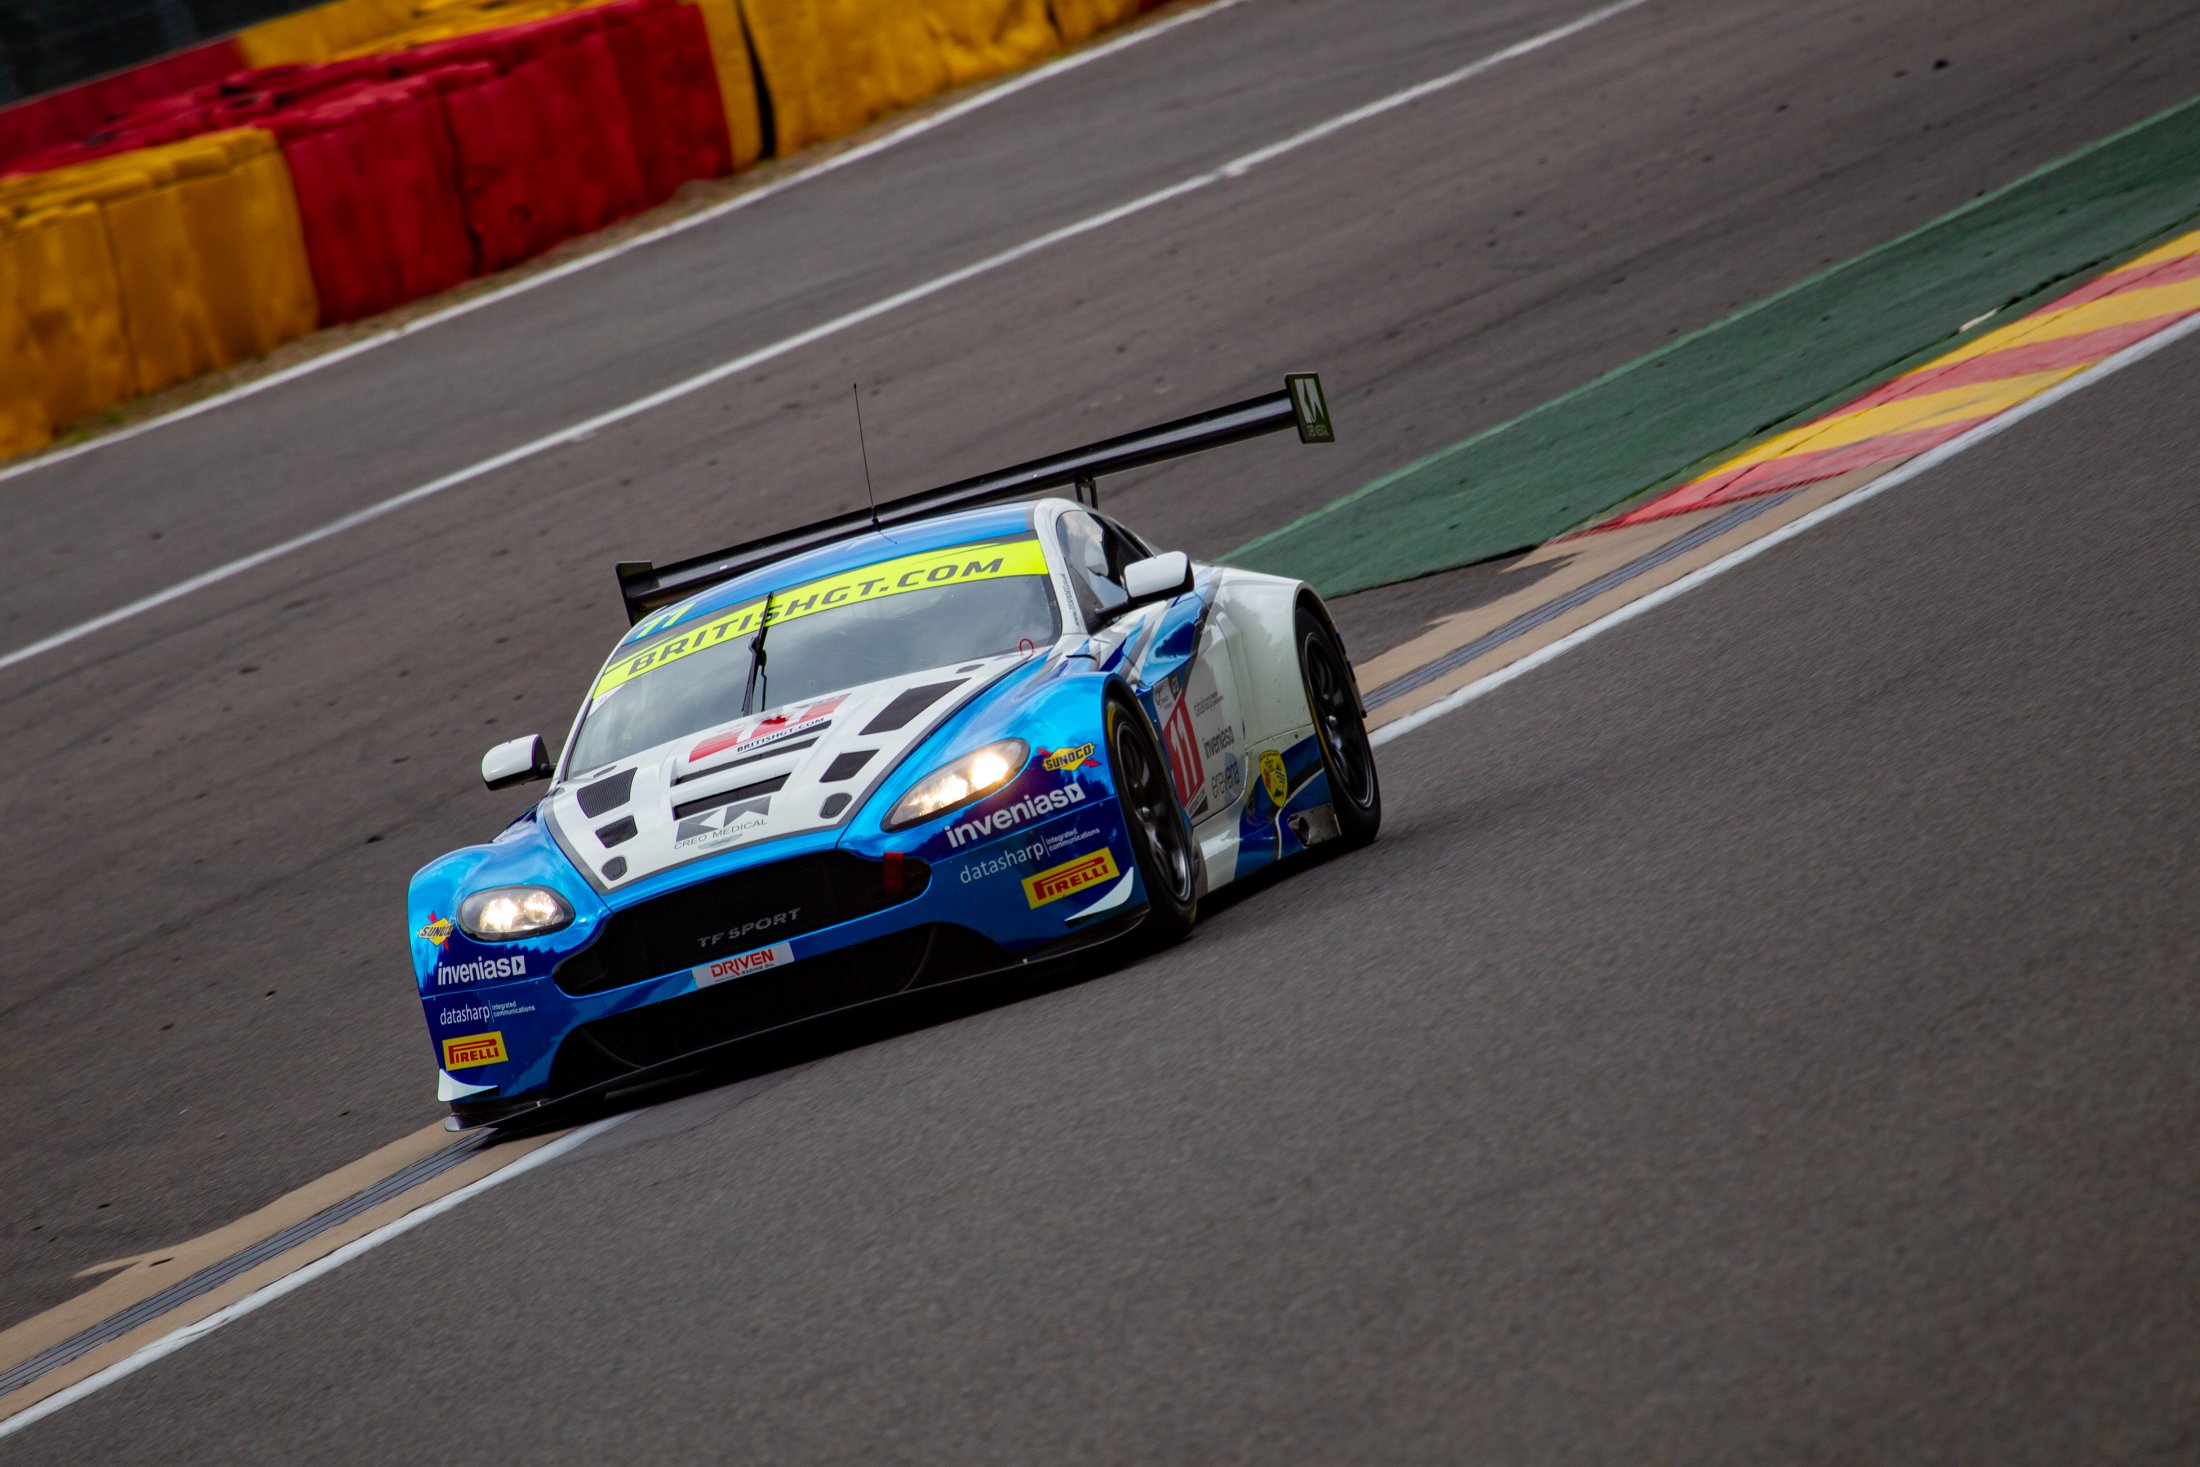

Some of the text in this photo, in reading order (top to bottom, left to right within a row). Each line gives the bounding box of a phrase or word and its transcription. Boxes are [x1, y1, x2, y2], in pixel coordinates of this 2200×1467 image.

[627, 558, 1003, 676] BRITISHGT.COM
[737, 717, 825, 752] BRITISHGT.COM
[1045, 744, 1092, 770] SUNOCO
[1170, 706, 1198, 800] 11
[944, 786, 1069, 848] invenias
[673, 834, 708, 850] CREO
[712, 819, 768, 839] MEDICAL
[1046, 828, 1078, 844] integrated
[1049, 828, 1100, 851] communications
[960, 842, 1044, 884] datasharp
[1033, 856, 1109, 900] PIRELLI
[698, 907, 801, 948] TF SPORT
[437, 956, 512, 986] invenias
[710, 948, 775, 977] DRIVEN
[439, 1003, 491, 1025] datasharp
[492, 1000, 517, 1011] integrated
[493, 1005, 536, 1018] communications
[448, 1038, 500, 1065] PIRELLI
